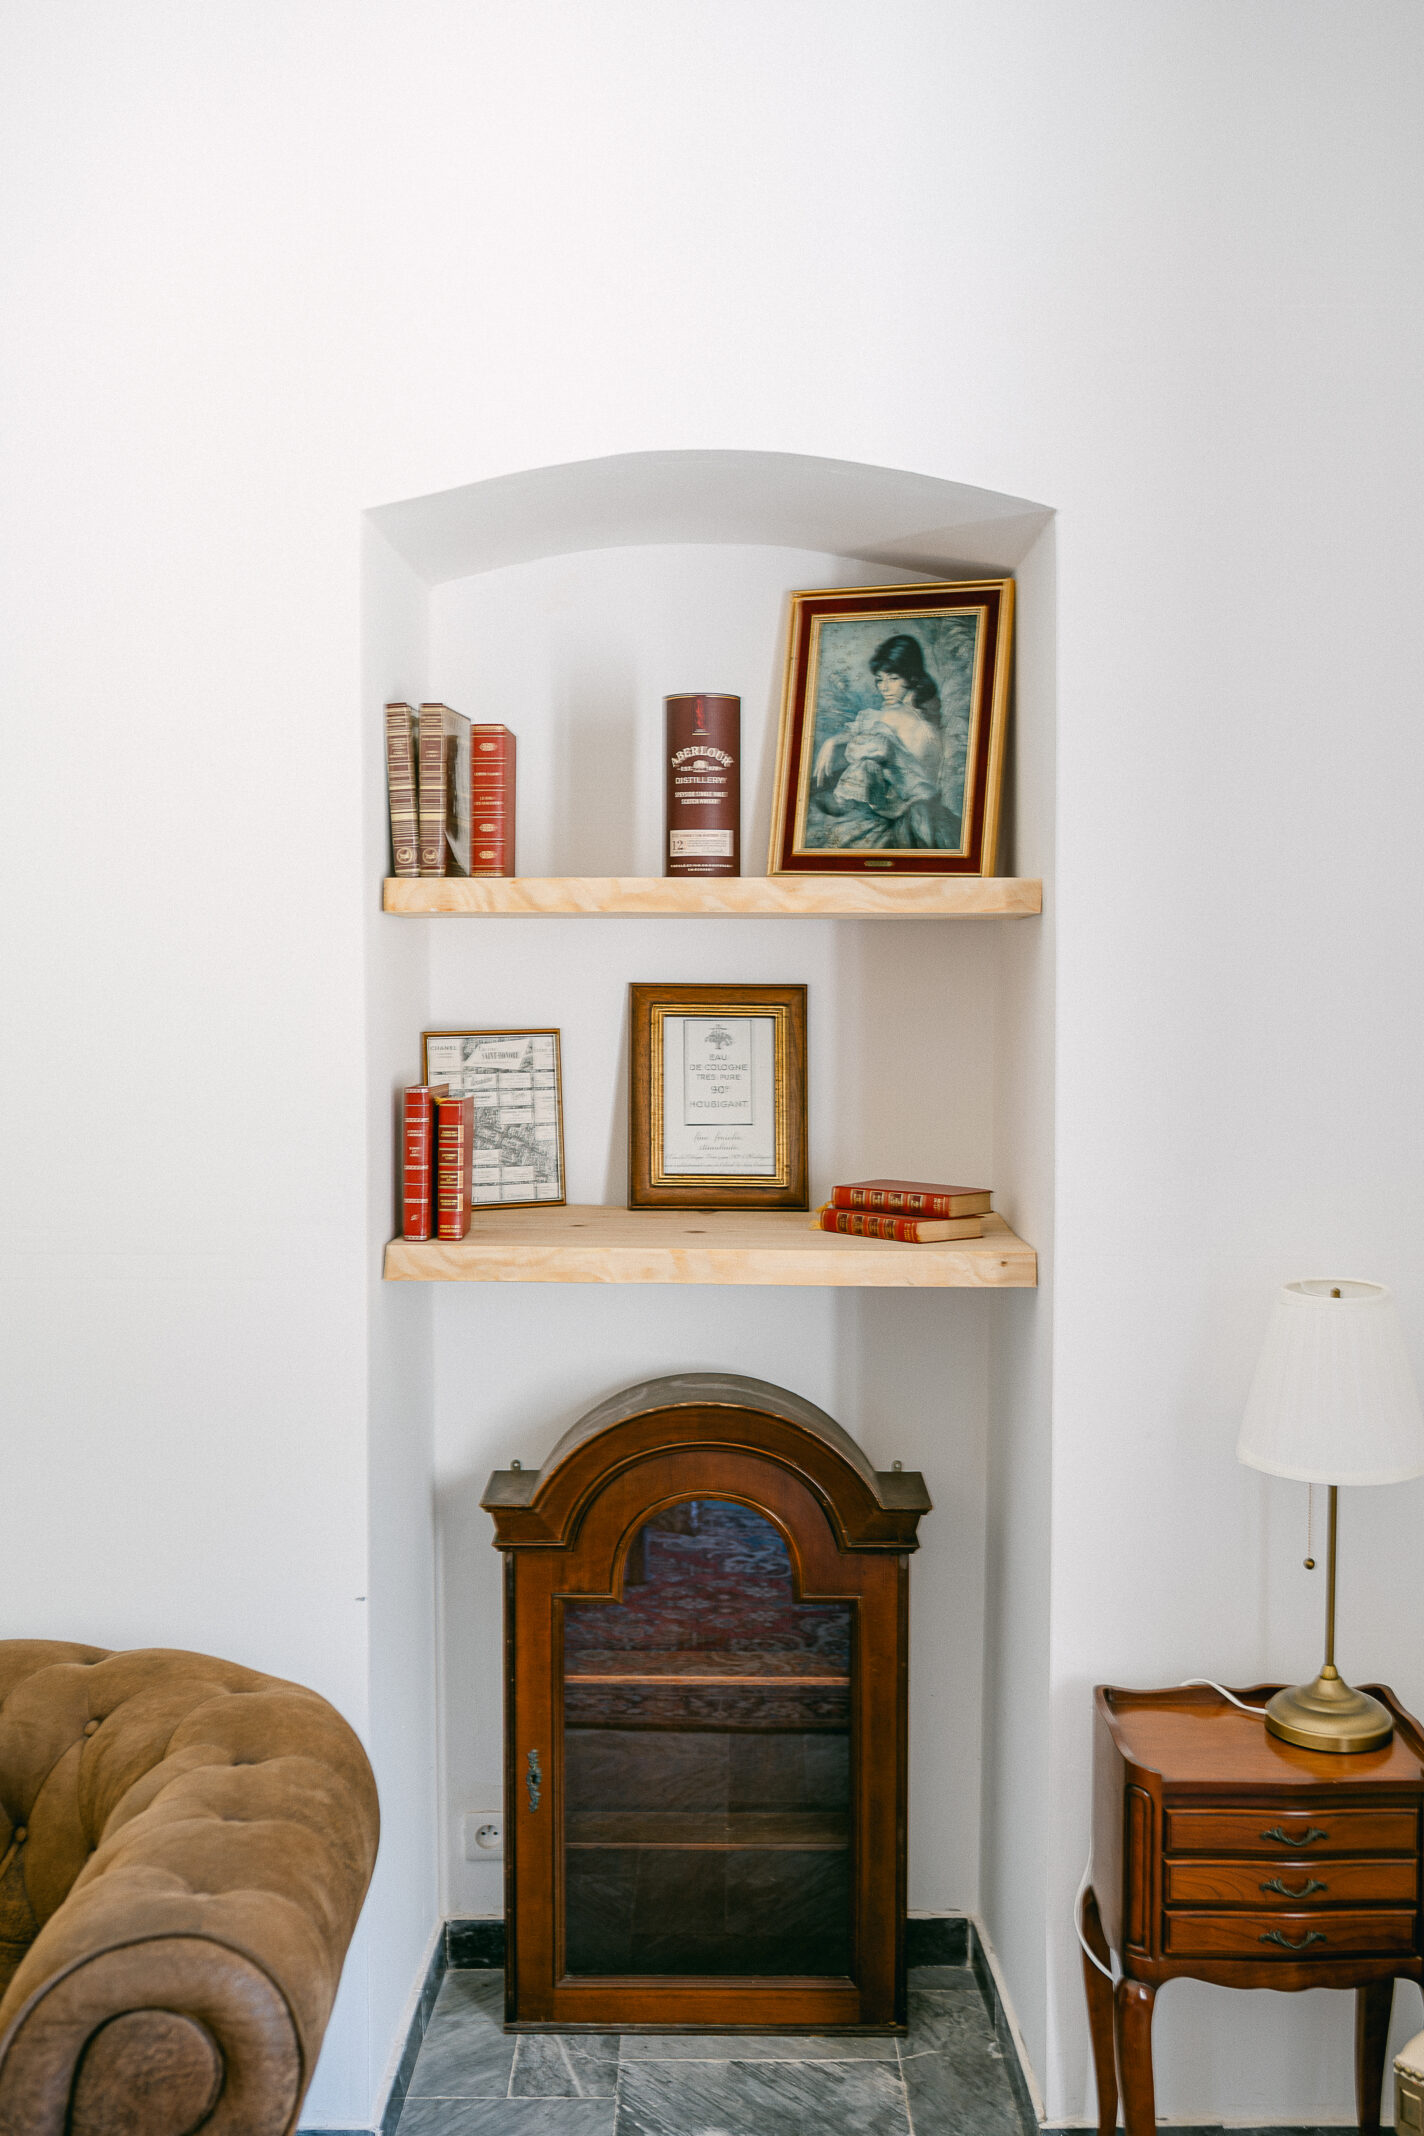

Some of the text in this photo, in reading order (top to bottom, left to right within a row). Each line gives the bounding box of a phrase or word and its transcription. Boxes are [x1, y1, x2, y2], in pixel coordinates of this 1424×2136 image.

[671, 746, 735, 768] ABERLOUR
[675, 777, 728, 785] DISTILLERY
[672, 840, 684, 851] 12
[689, 1063, 749, 1071] DE COLOGNE
[719, 1073, 742, 1081] PURE
